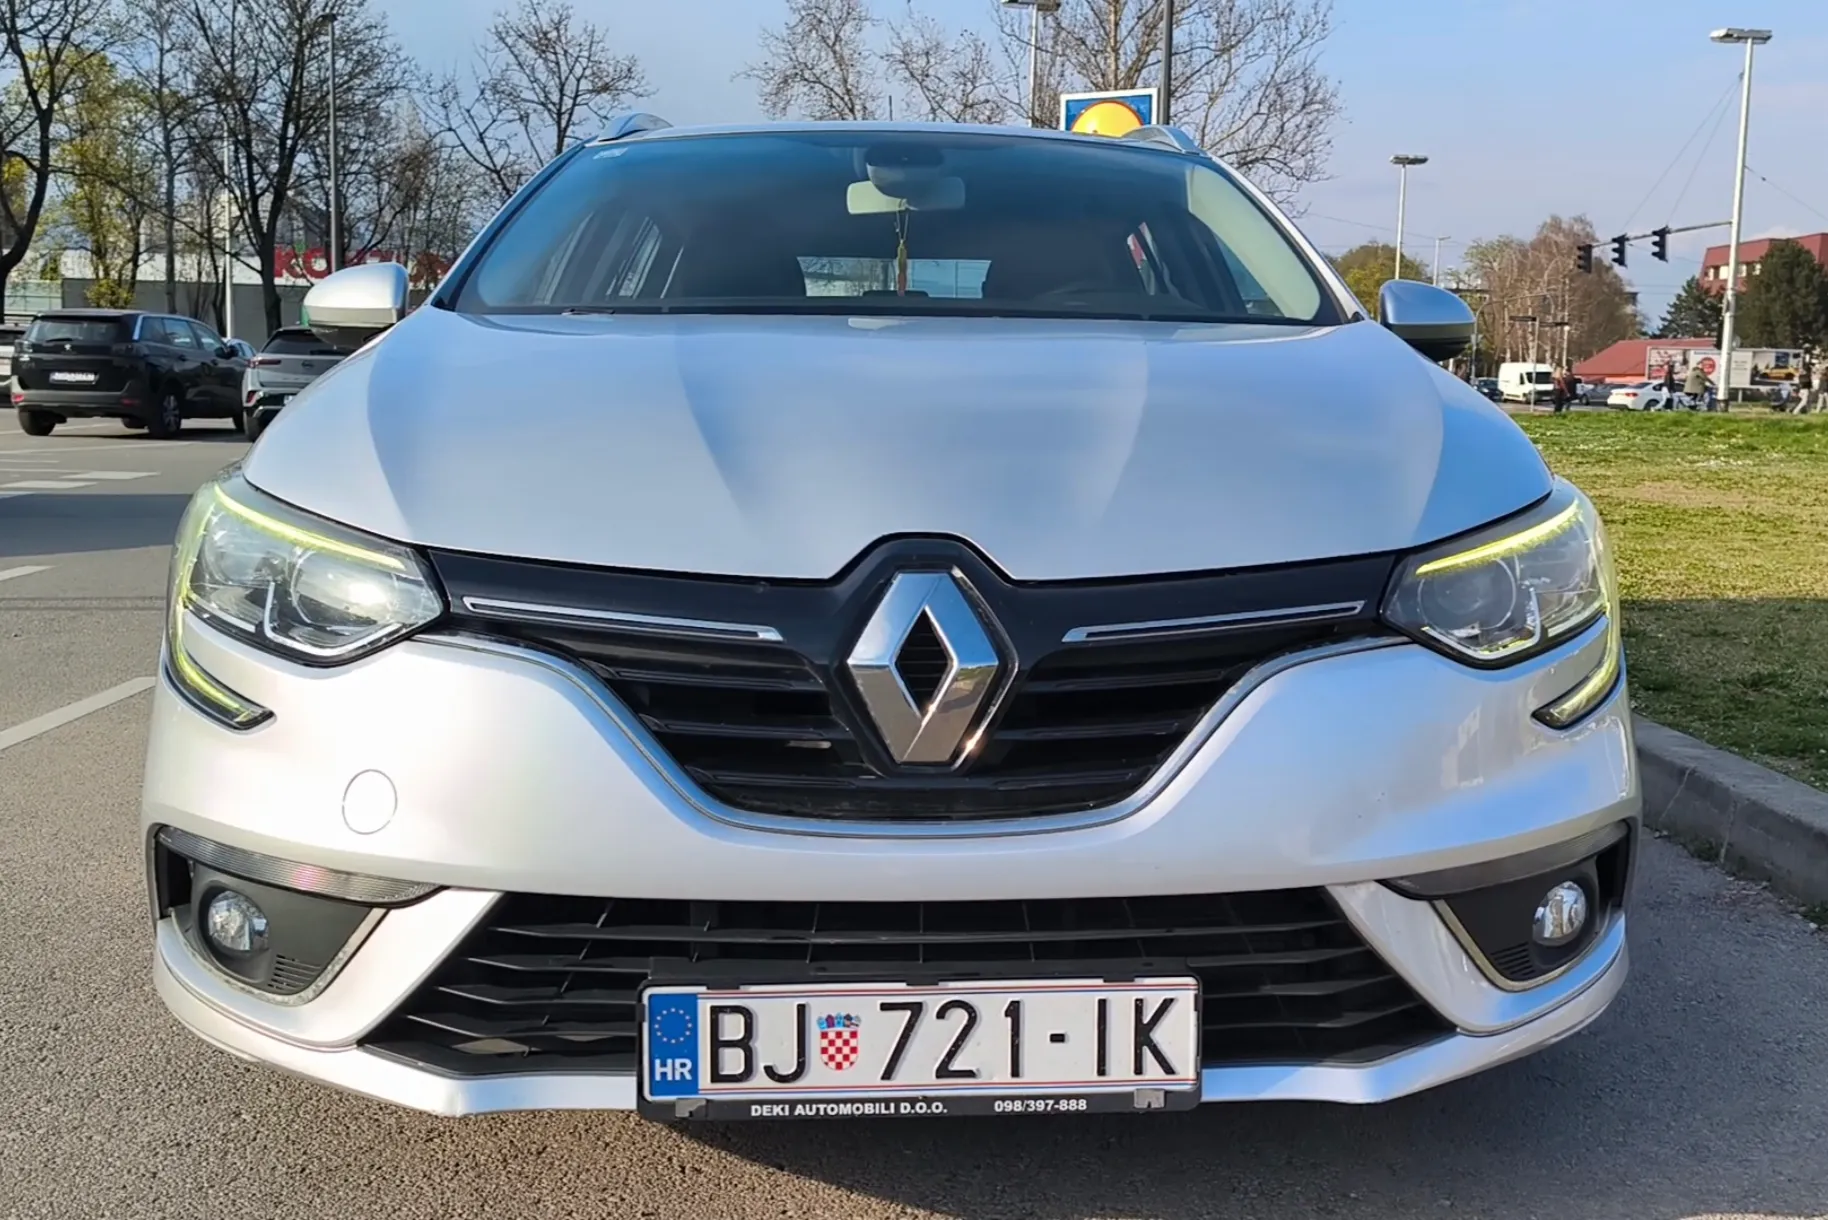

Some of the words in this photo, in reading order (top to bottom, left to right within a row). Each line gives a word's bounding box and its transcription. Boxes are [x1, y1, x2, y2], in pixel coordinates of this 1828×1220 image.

[710, 1003, 807, 1084] BJ
[654, 1058, 693, 1081] HR
[750, 1104, 789, 1117] DEKI
[794, 1102, 894, 1117] AUTOMOBILI
[900, 1101, 948, 1114] D.O.O.
[994, 1098, 1087, 1113] 098/397-888
